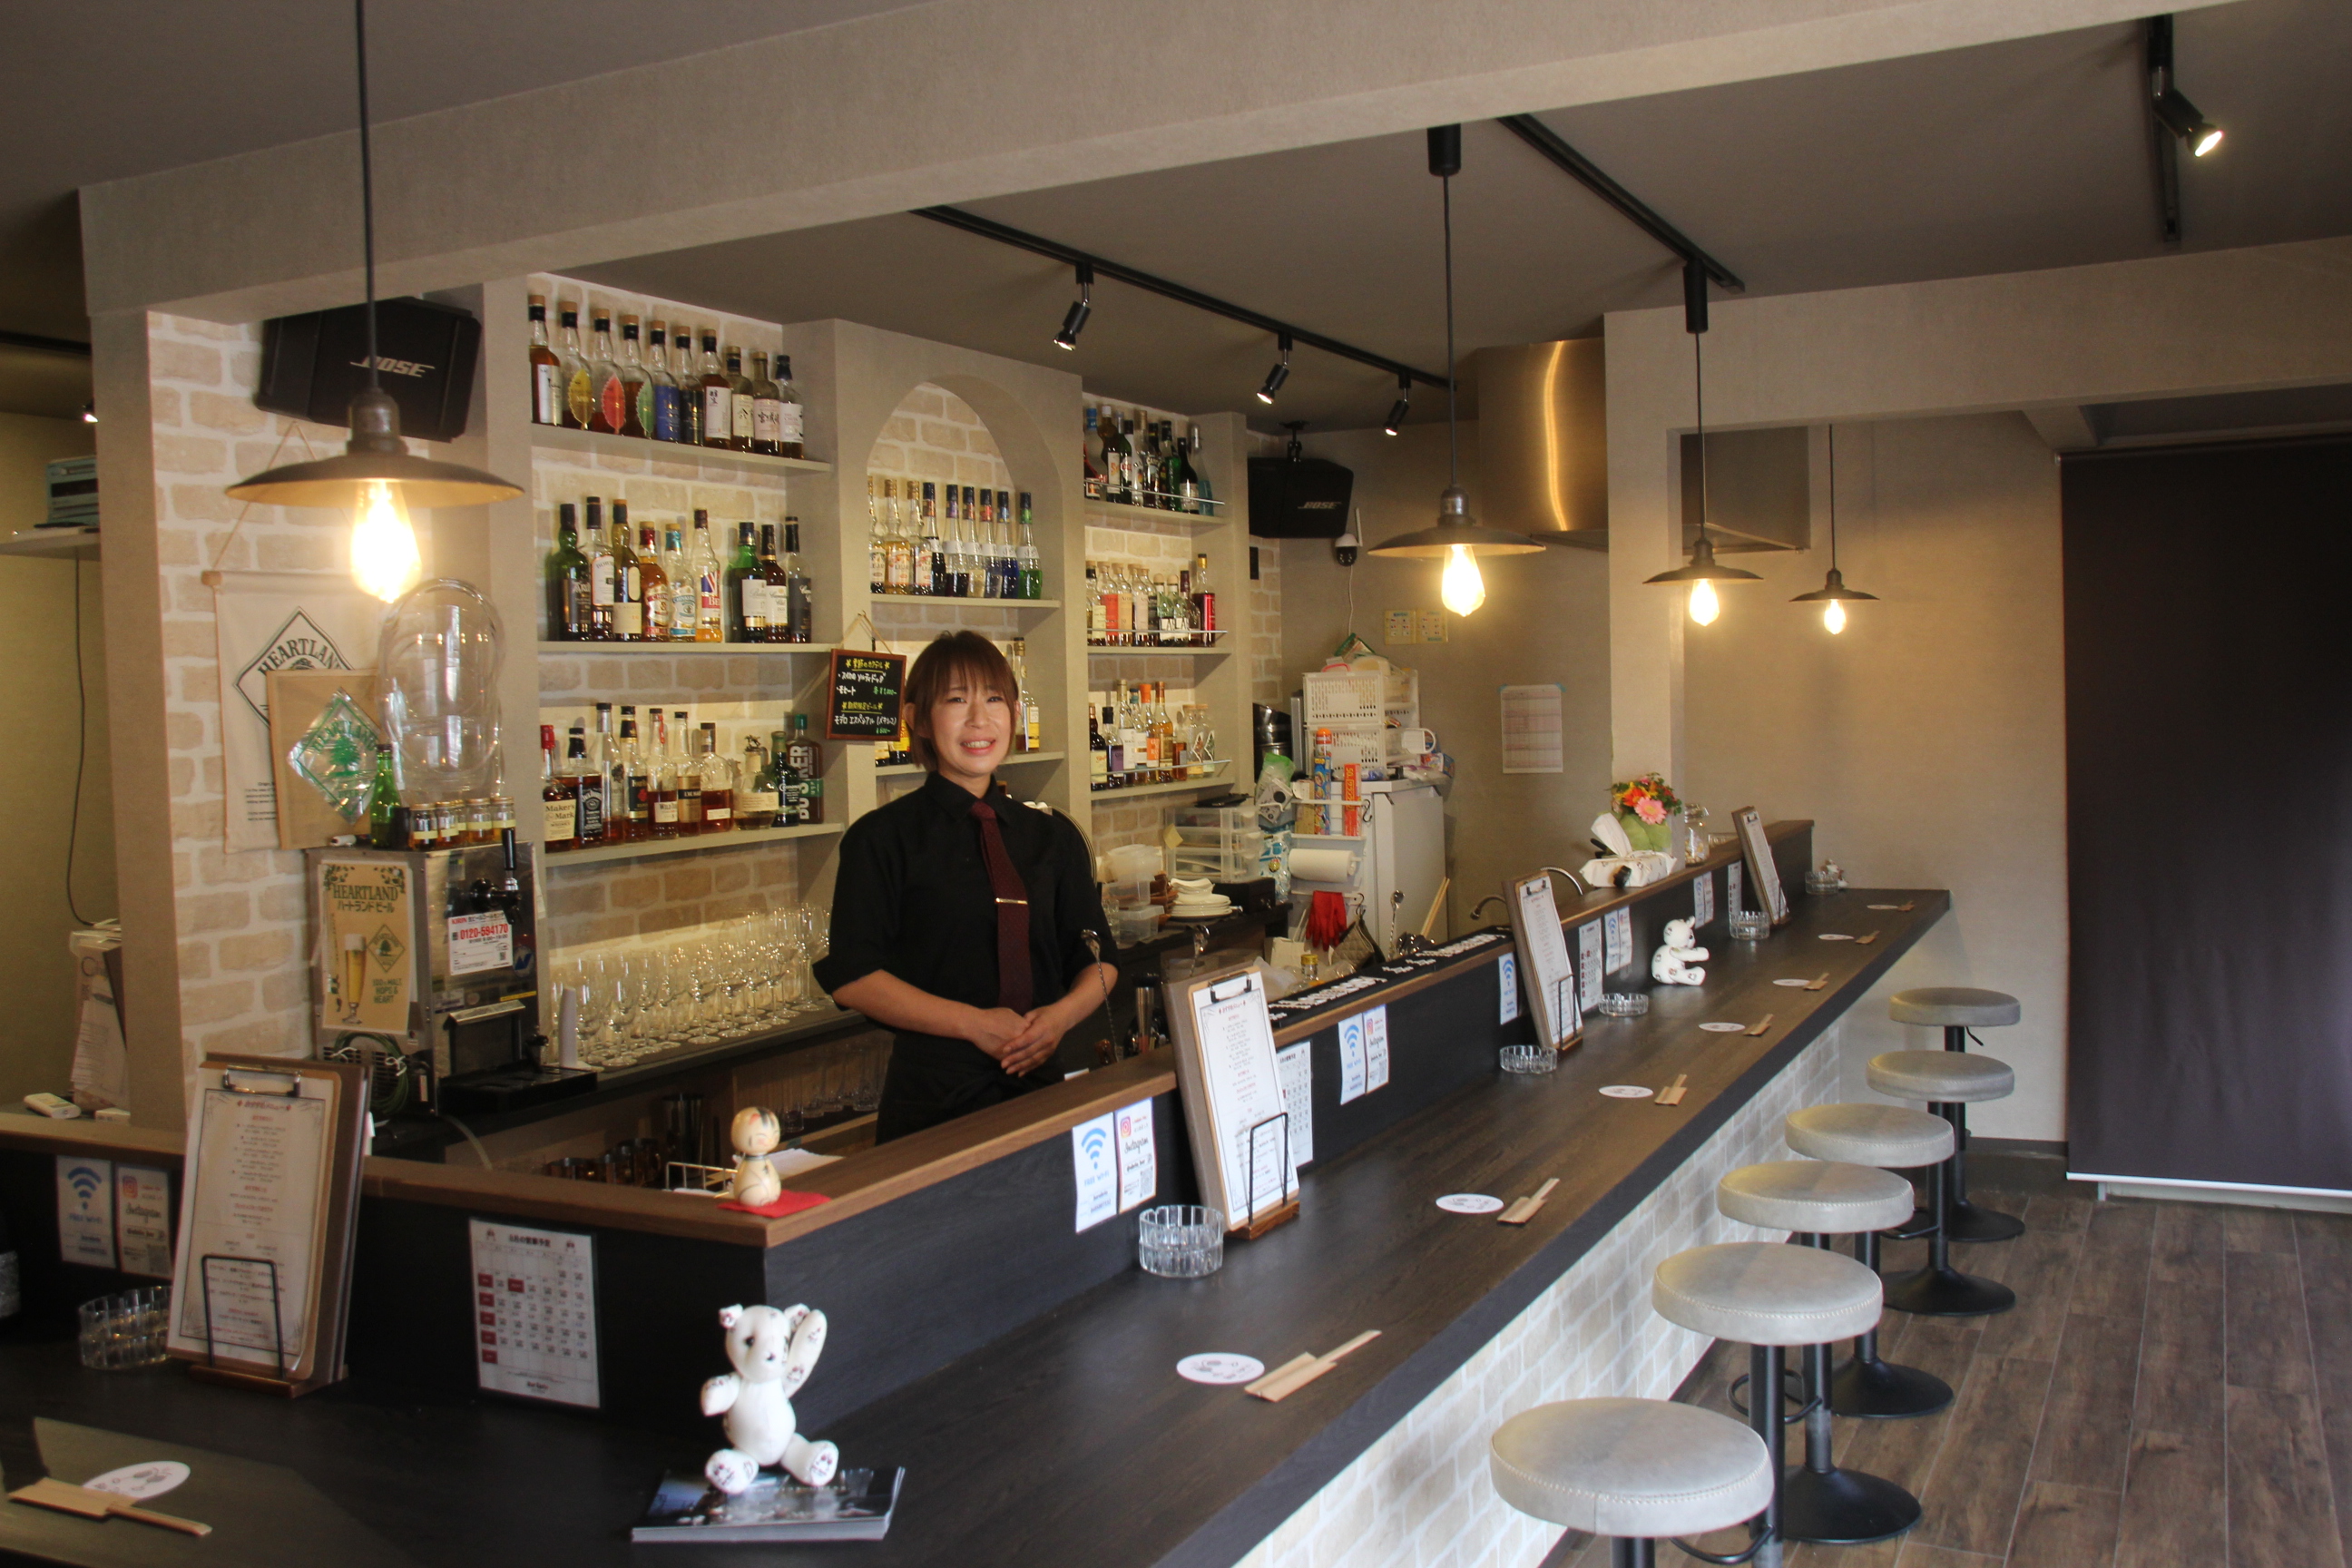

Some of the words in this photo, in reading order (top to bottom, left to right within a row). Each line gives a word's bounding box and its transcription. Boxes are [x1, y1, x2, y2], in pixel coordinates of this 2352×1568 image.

[257, 638, 342, 675] HEARTLAN
[332, 885, 398, 901] HEARTLAND
[1124, 1136, 1149, 1155] Instagram
